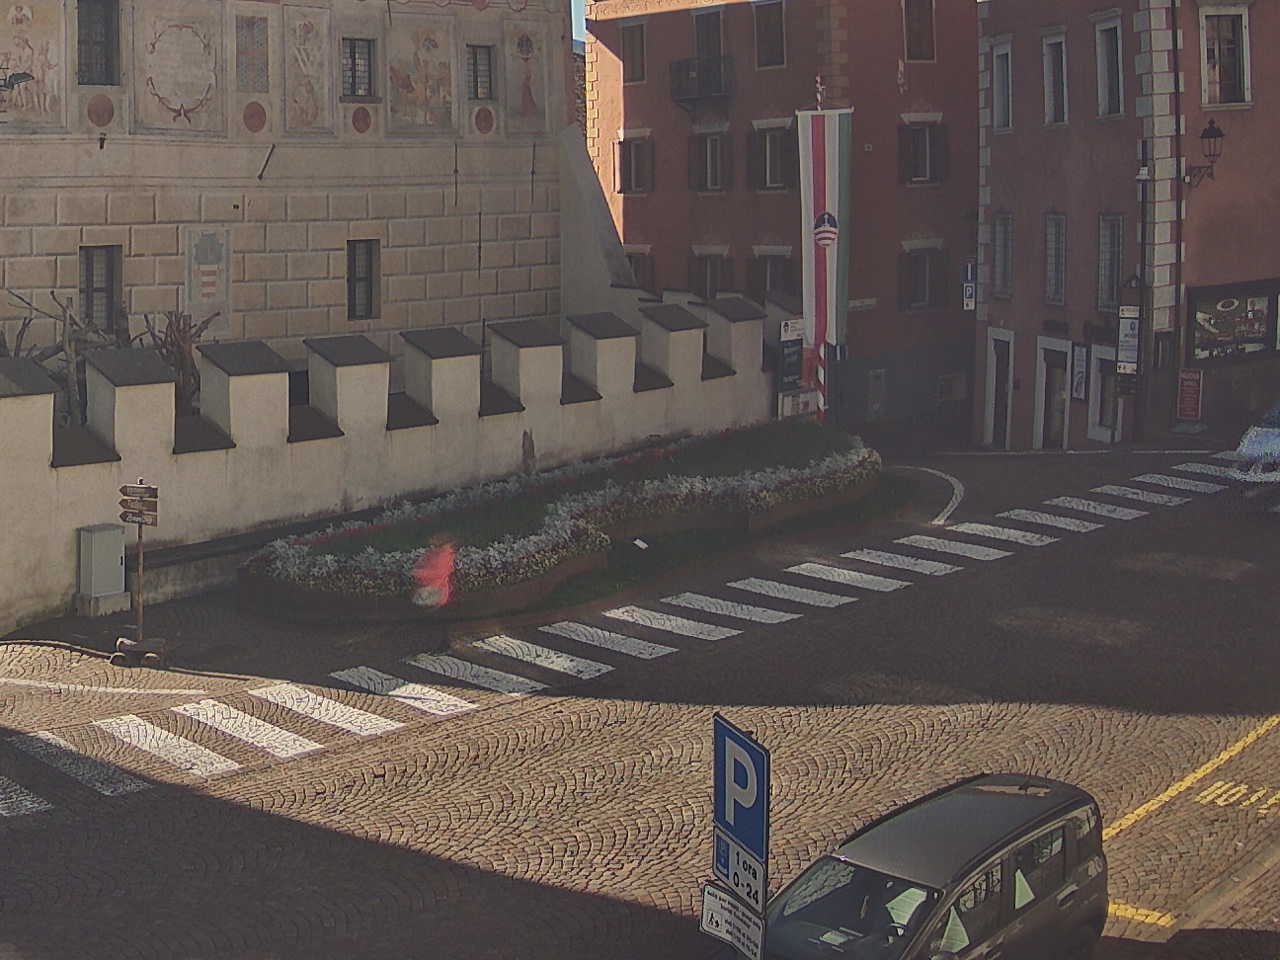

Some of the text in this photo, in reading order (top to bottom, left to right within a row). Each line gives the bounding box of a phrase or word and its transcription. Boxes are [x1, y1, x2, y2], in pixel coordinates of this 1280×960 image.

[725, 736, 758, 826] P
[735, 850, 758, 881] 1 ora
